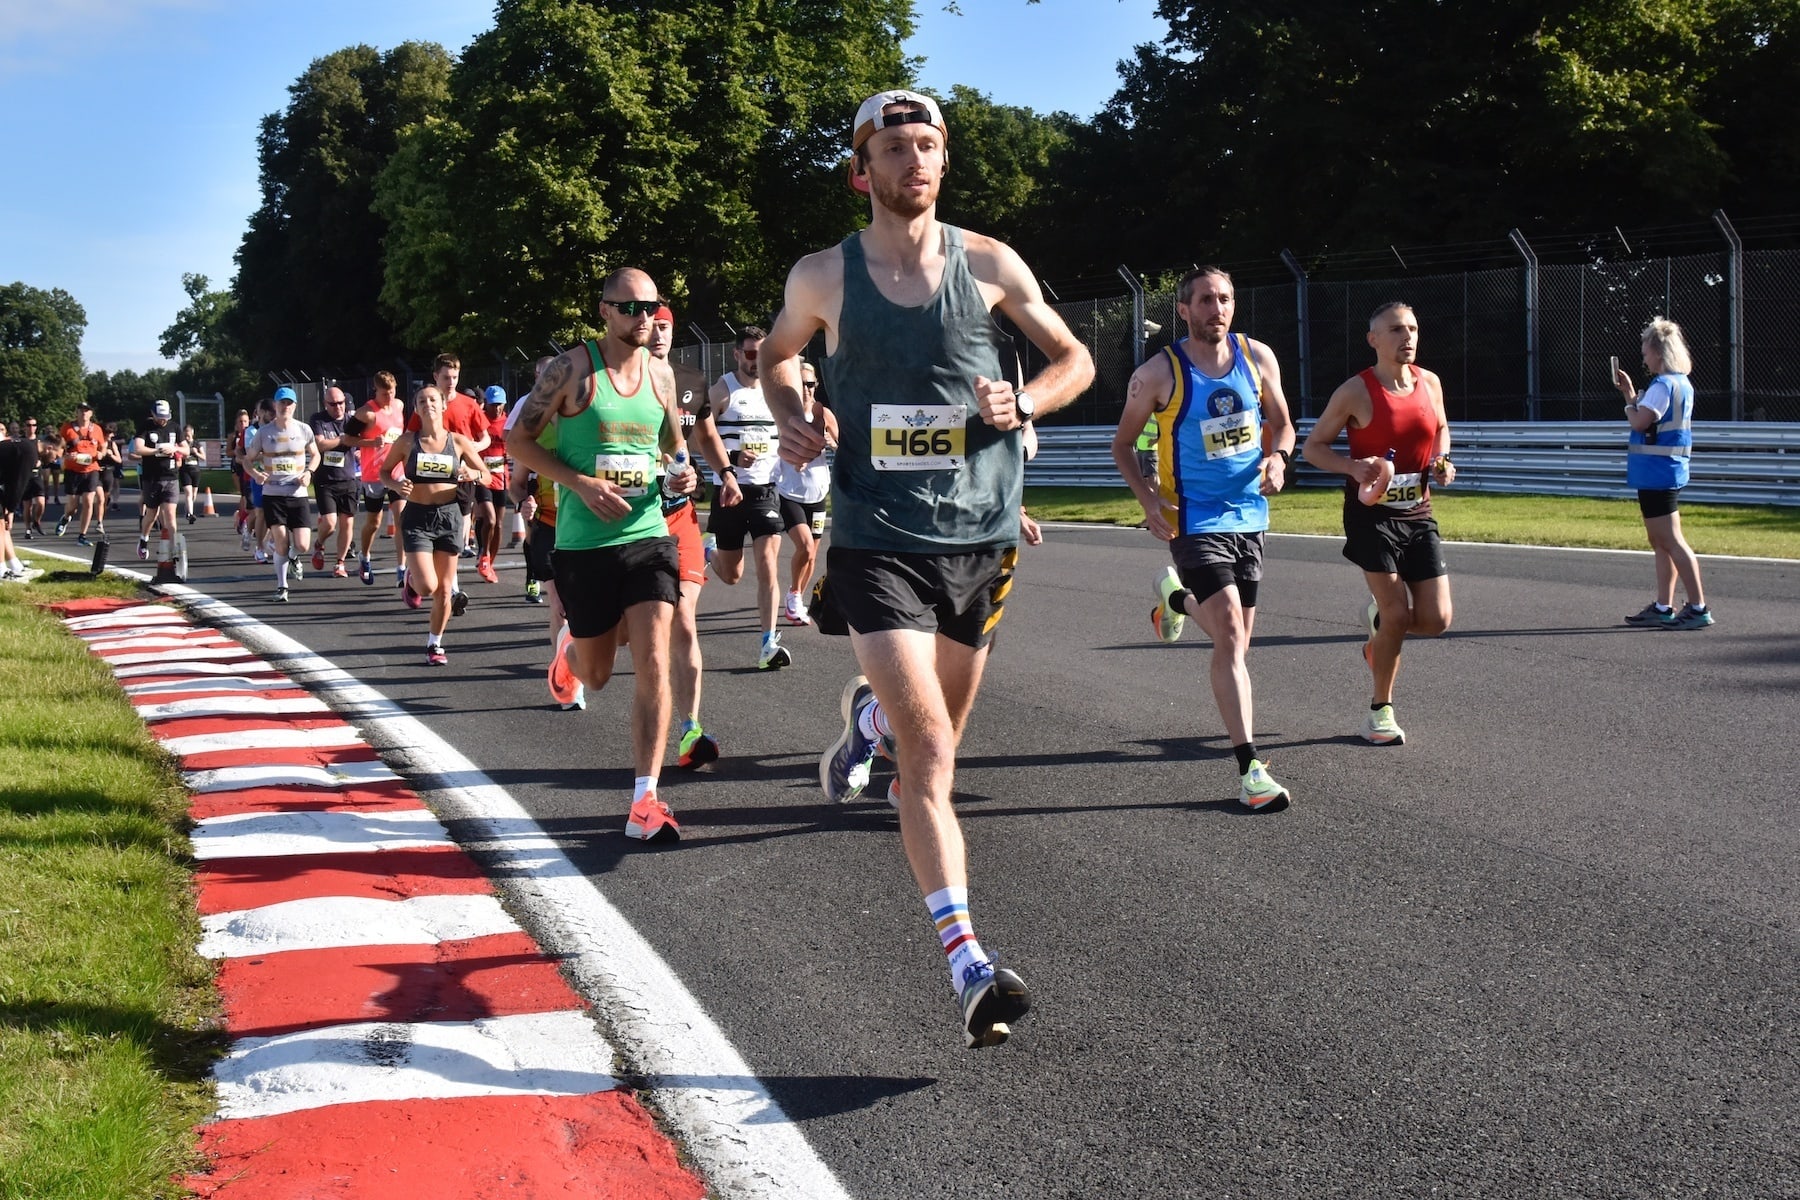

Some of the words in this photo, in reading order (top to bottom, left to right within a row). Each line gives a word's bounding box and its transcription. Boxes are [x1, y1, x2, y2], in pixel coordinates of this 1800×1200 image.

[886, 429, 952, 456] 466
[1211, 425, 1252, 448] 455
[745, 442, 769, 454] 443
[276, 463, 293, 471] 514
[422, 461, 448, 474] 522
[605, 470, 643, 488] 458
[1386, 486, 1416, 502] 516
